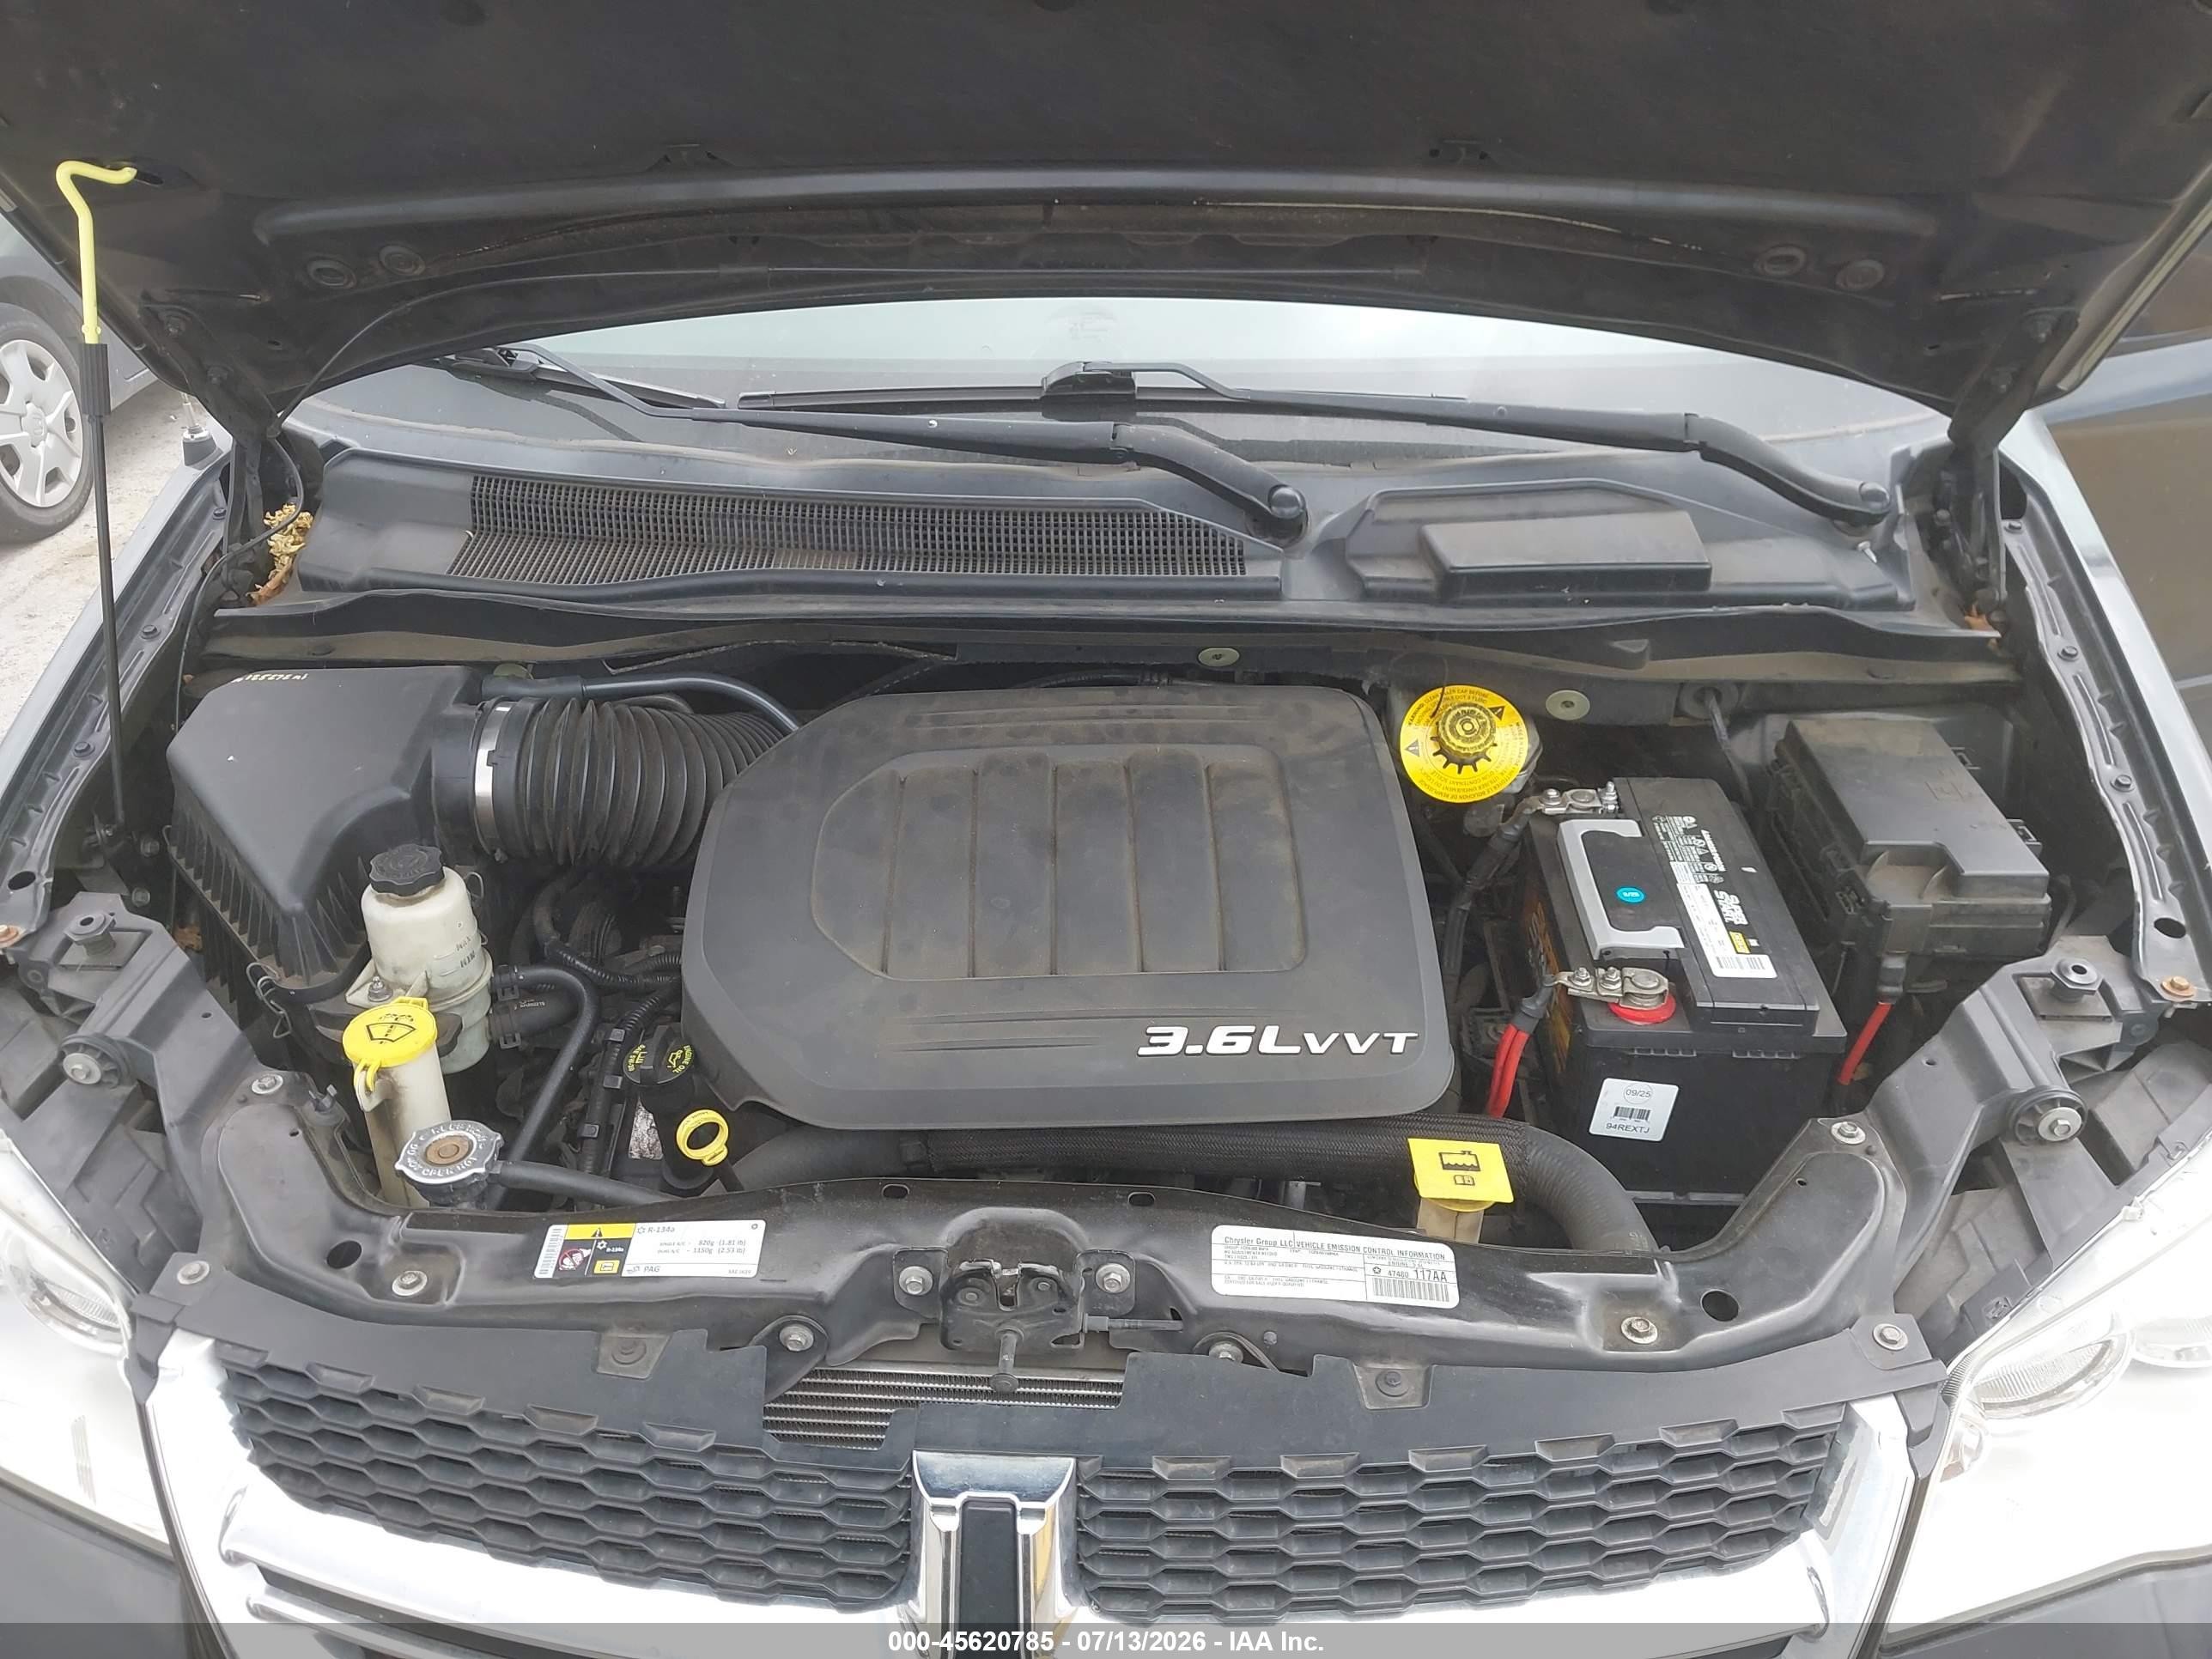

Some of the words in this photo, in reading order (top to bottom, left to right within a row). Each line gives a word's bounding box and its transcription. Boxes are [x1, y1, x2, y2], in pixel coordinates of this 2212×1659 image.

[1137, 1025, 1302, 1056] 3.6L
[683, 1045, 693, 1066] ENGINE
[672, 1065, 685, 1073] OIL
[1626, 1088, 1651, 1098] 09/25
[1606, 1122, 1650, 1134] 94REXTJ
[1224, 1236, 1254, 1245] Chrysler
[1256, 1237, 1278, 1248] Group
[1279, 1239, 1293, 1248] LLC
[693, 1247, 714, 1255] 1150g
[717, 1247, 735, 1255] (2.53
[737, 1247, 746, 1255] lb)
[1296, 1241, 1324, 1250] VEHICLE
[1327, 1243, 1360, 1253] EMISSION
[1363, 1246, 1395, 1256] CONTROL
[1397, 1249, 1445, 1261] INFORMATION
[1414, 1268, 1448, 1282] 117AA
